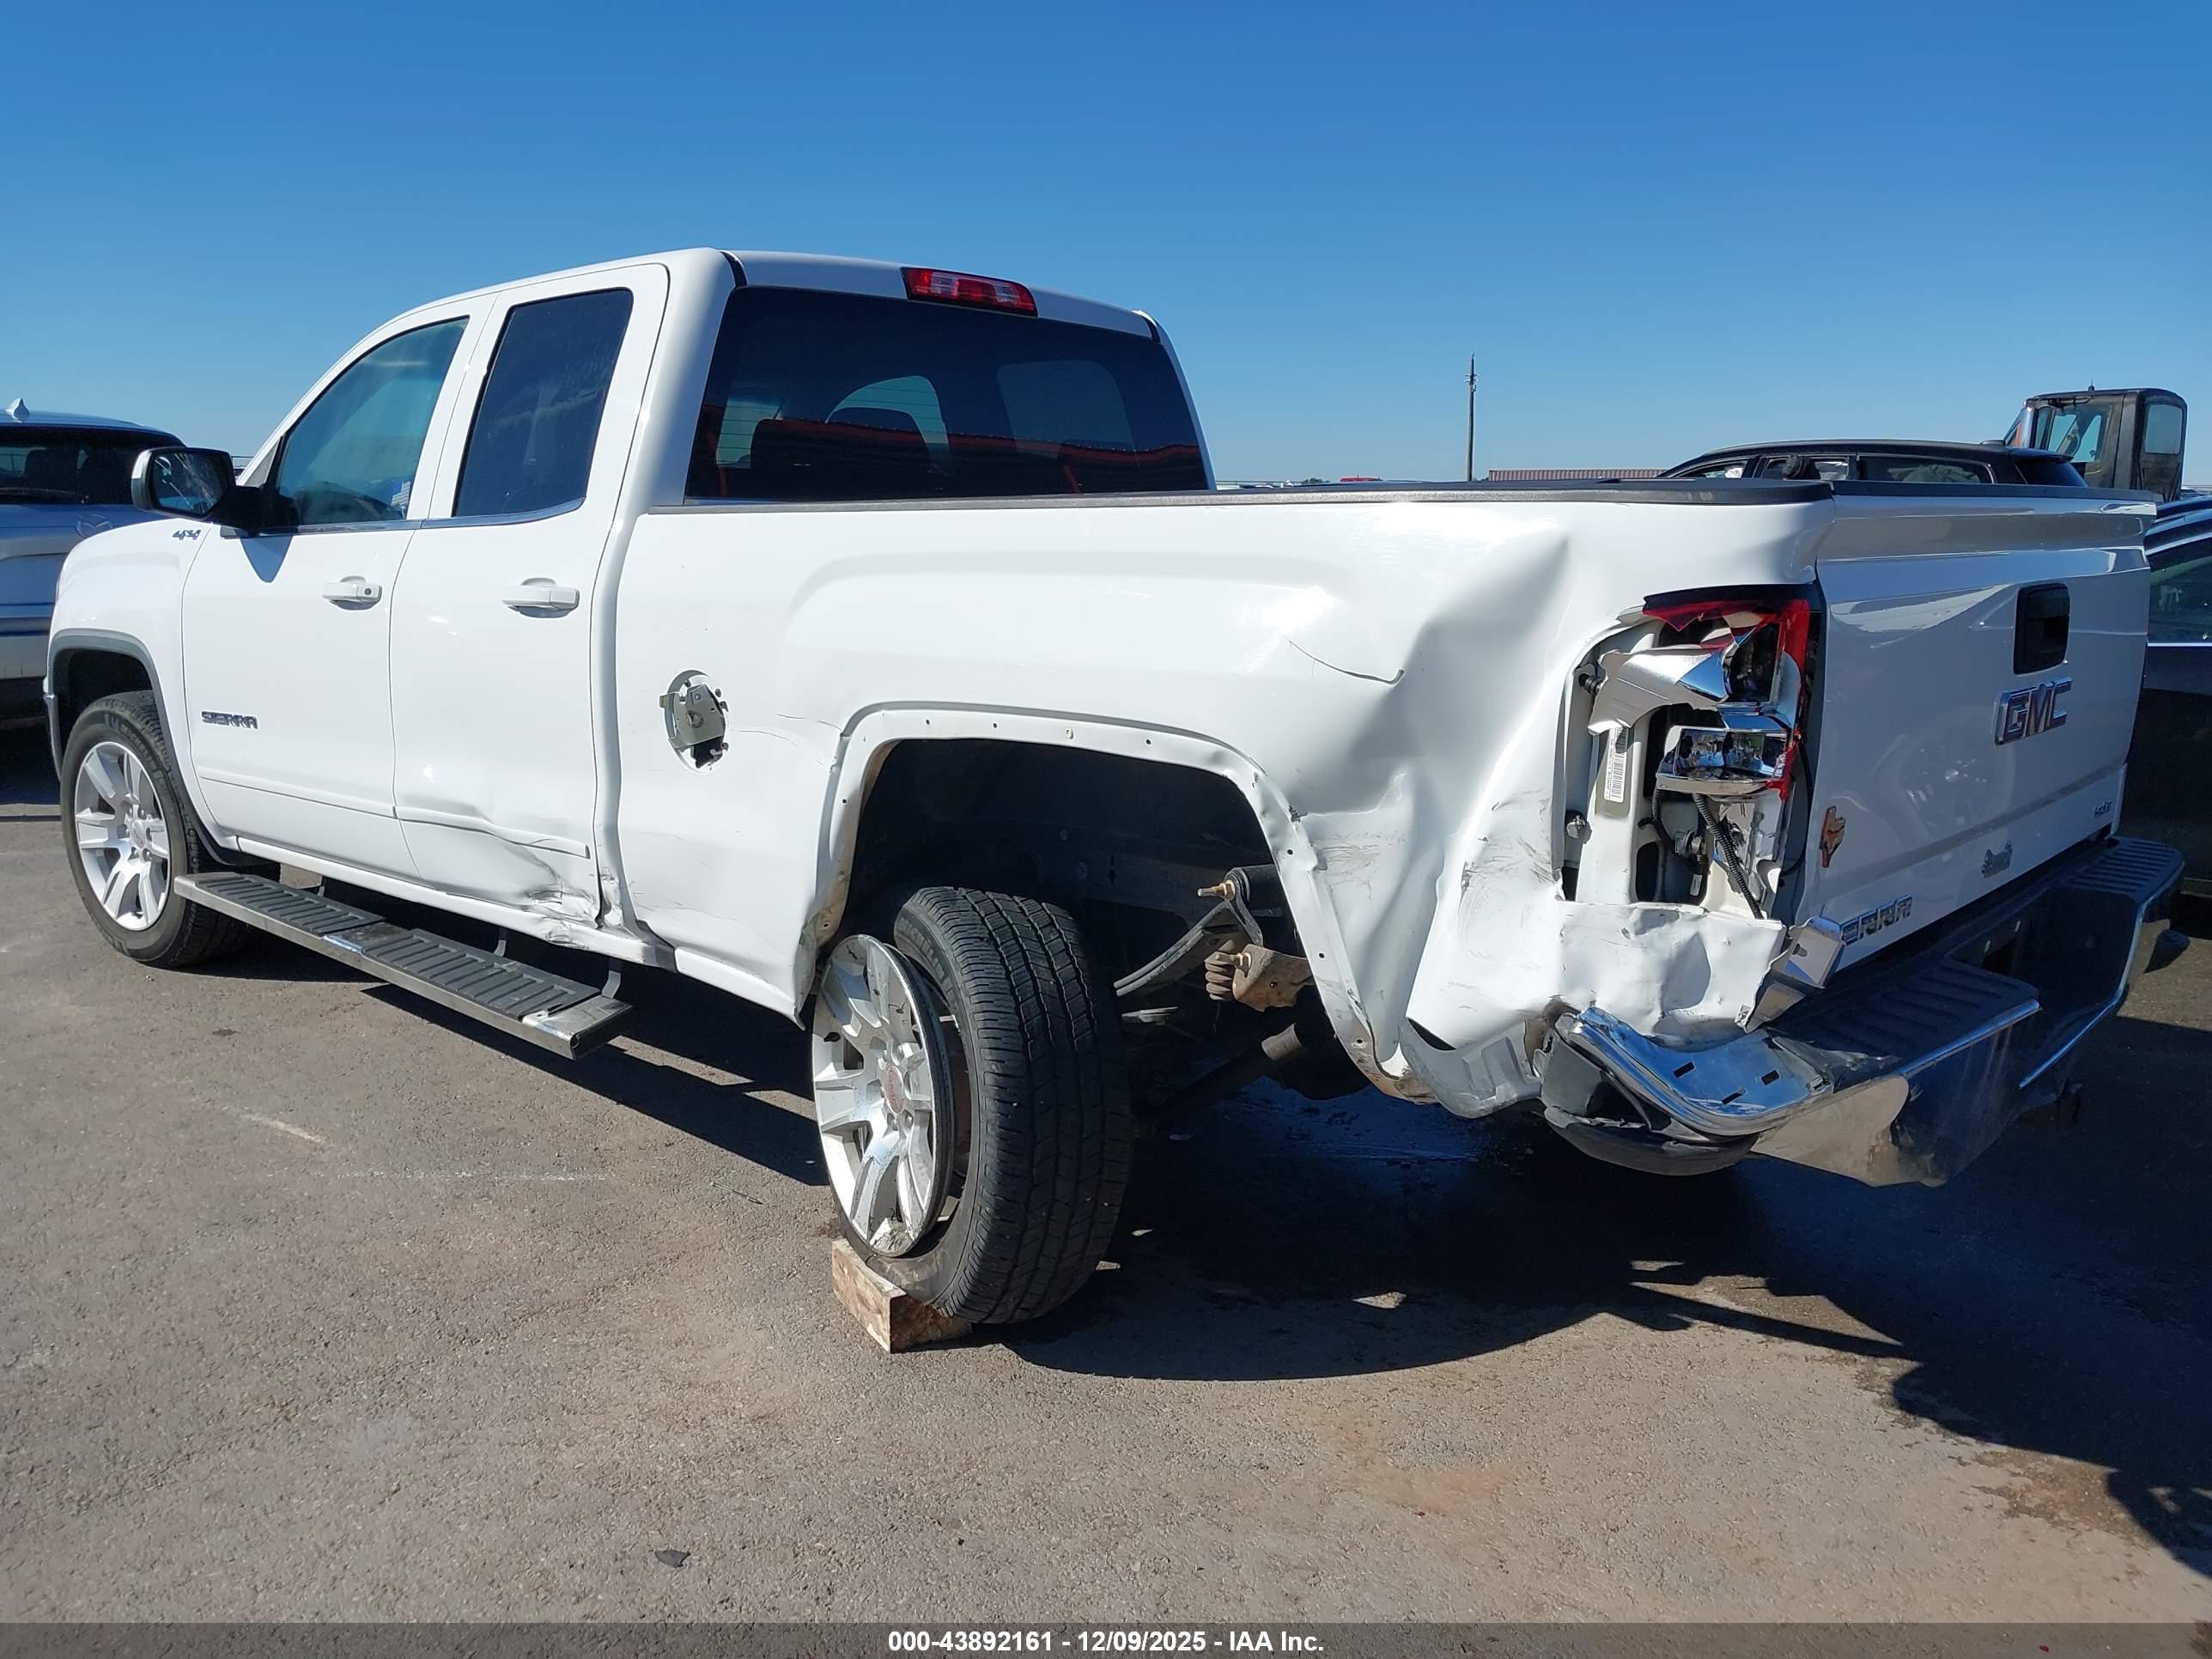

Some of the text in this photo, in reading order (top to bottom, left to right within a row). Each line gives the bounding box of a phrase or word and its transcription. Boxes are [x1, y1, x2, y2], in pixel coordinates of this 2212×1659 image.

[201, 710, 258, 730] SIERRA
[1994, 676, 2074, 745] GMC
[1839, 893, 1913, 946] ERRA
